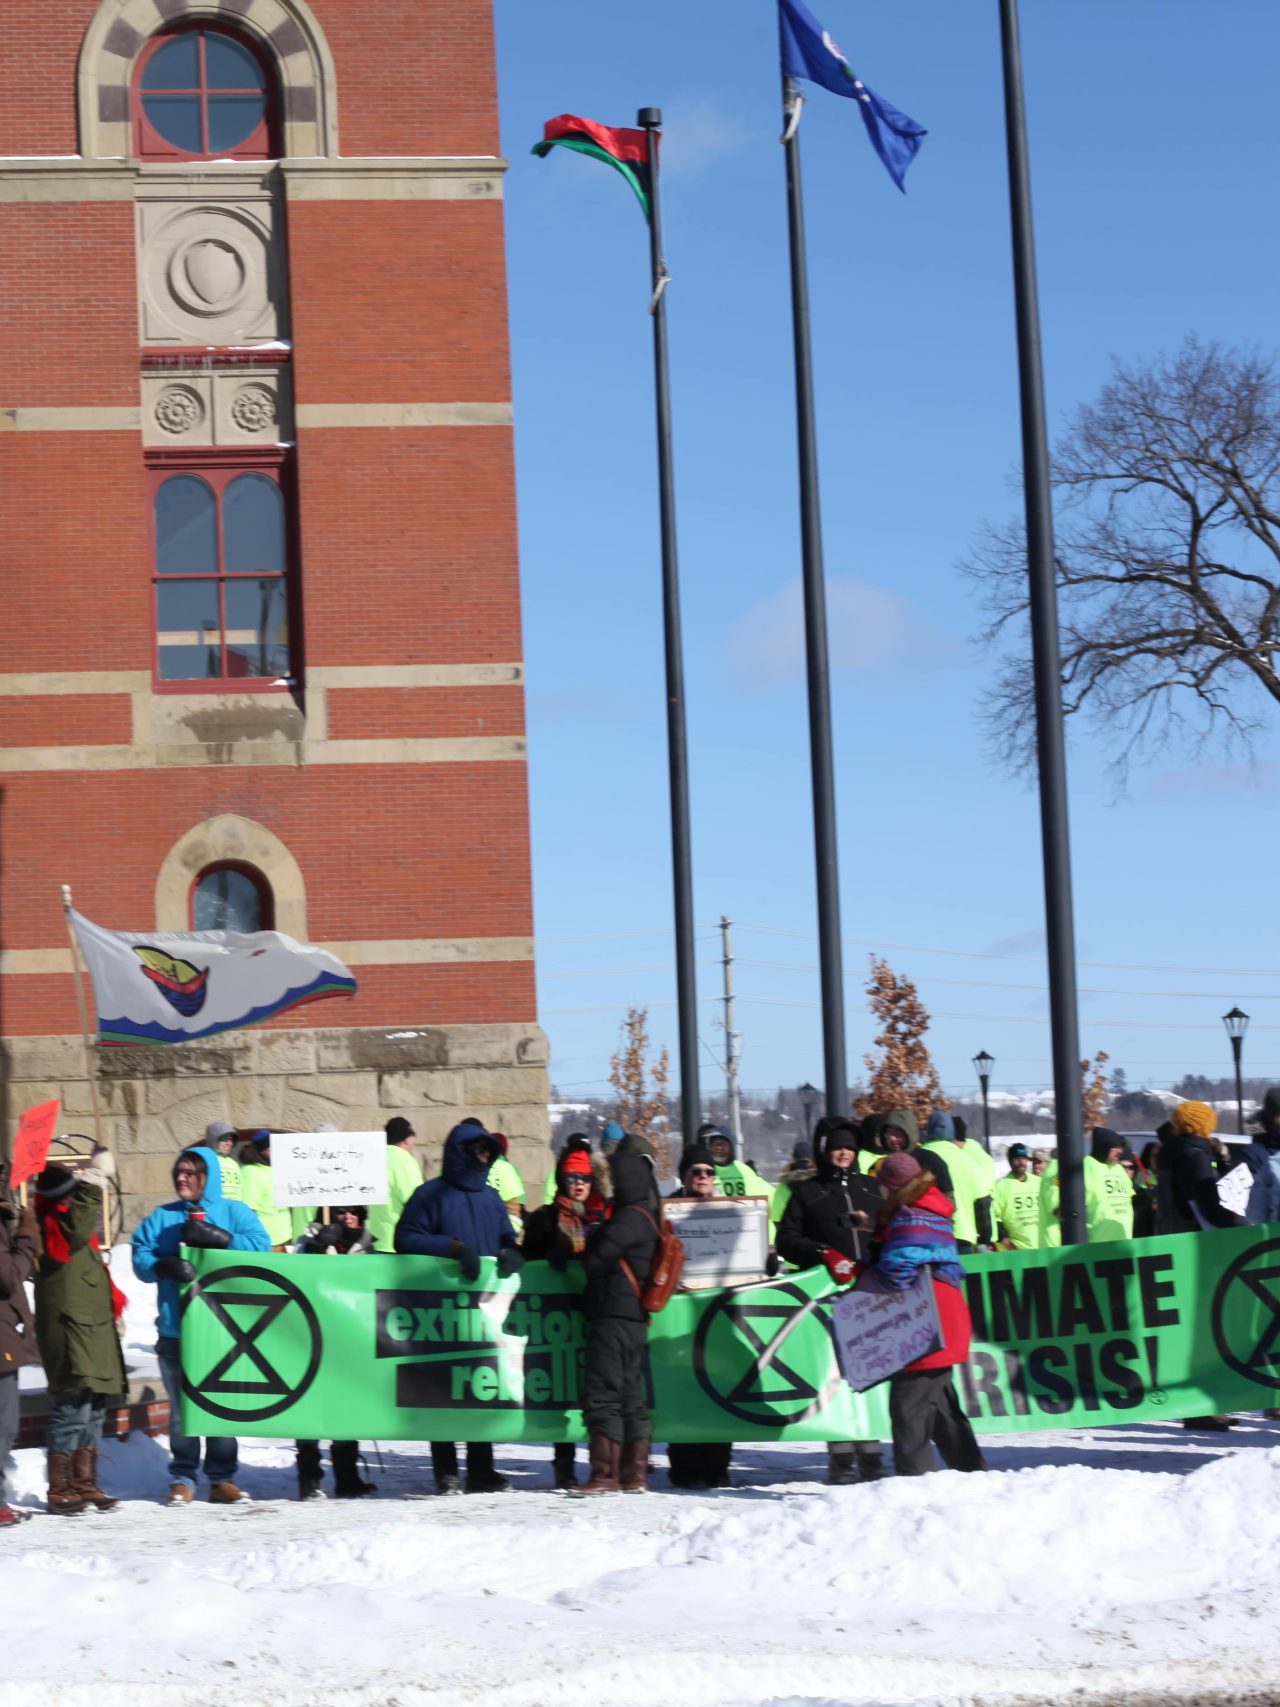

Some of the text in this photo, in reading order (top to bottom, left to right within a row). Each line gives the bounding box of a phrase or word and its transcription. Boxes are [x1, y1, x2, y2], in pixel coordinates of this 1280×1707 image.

[290, 1144, 363, 1164] Solidarity
[317, 1165, 350, 1175] with
[723, 1182, 746, 1196] 08
[966, 1253, 1181, 1343] IMATE
[960, 1336, 1159, 1418] RISIS!
